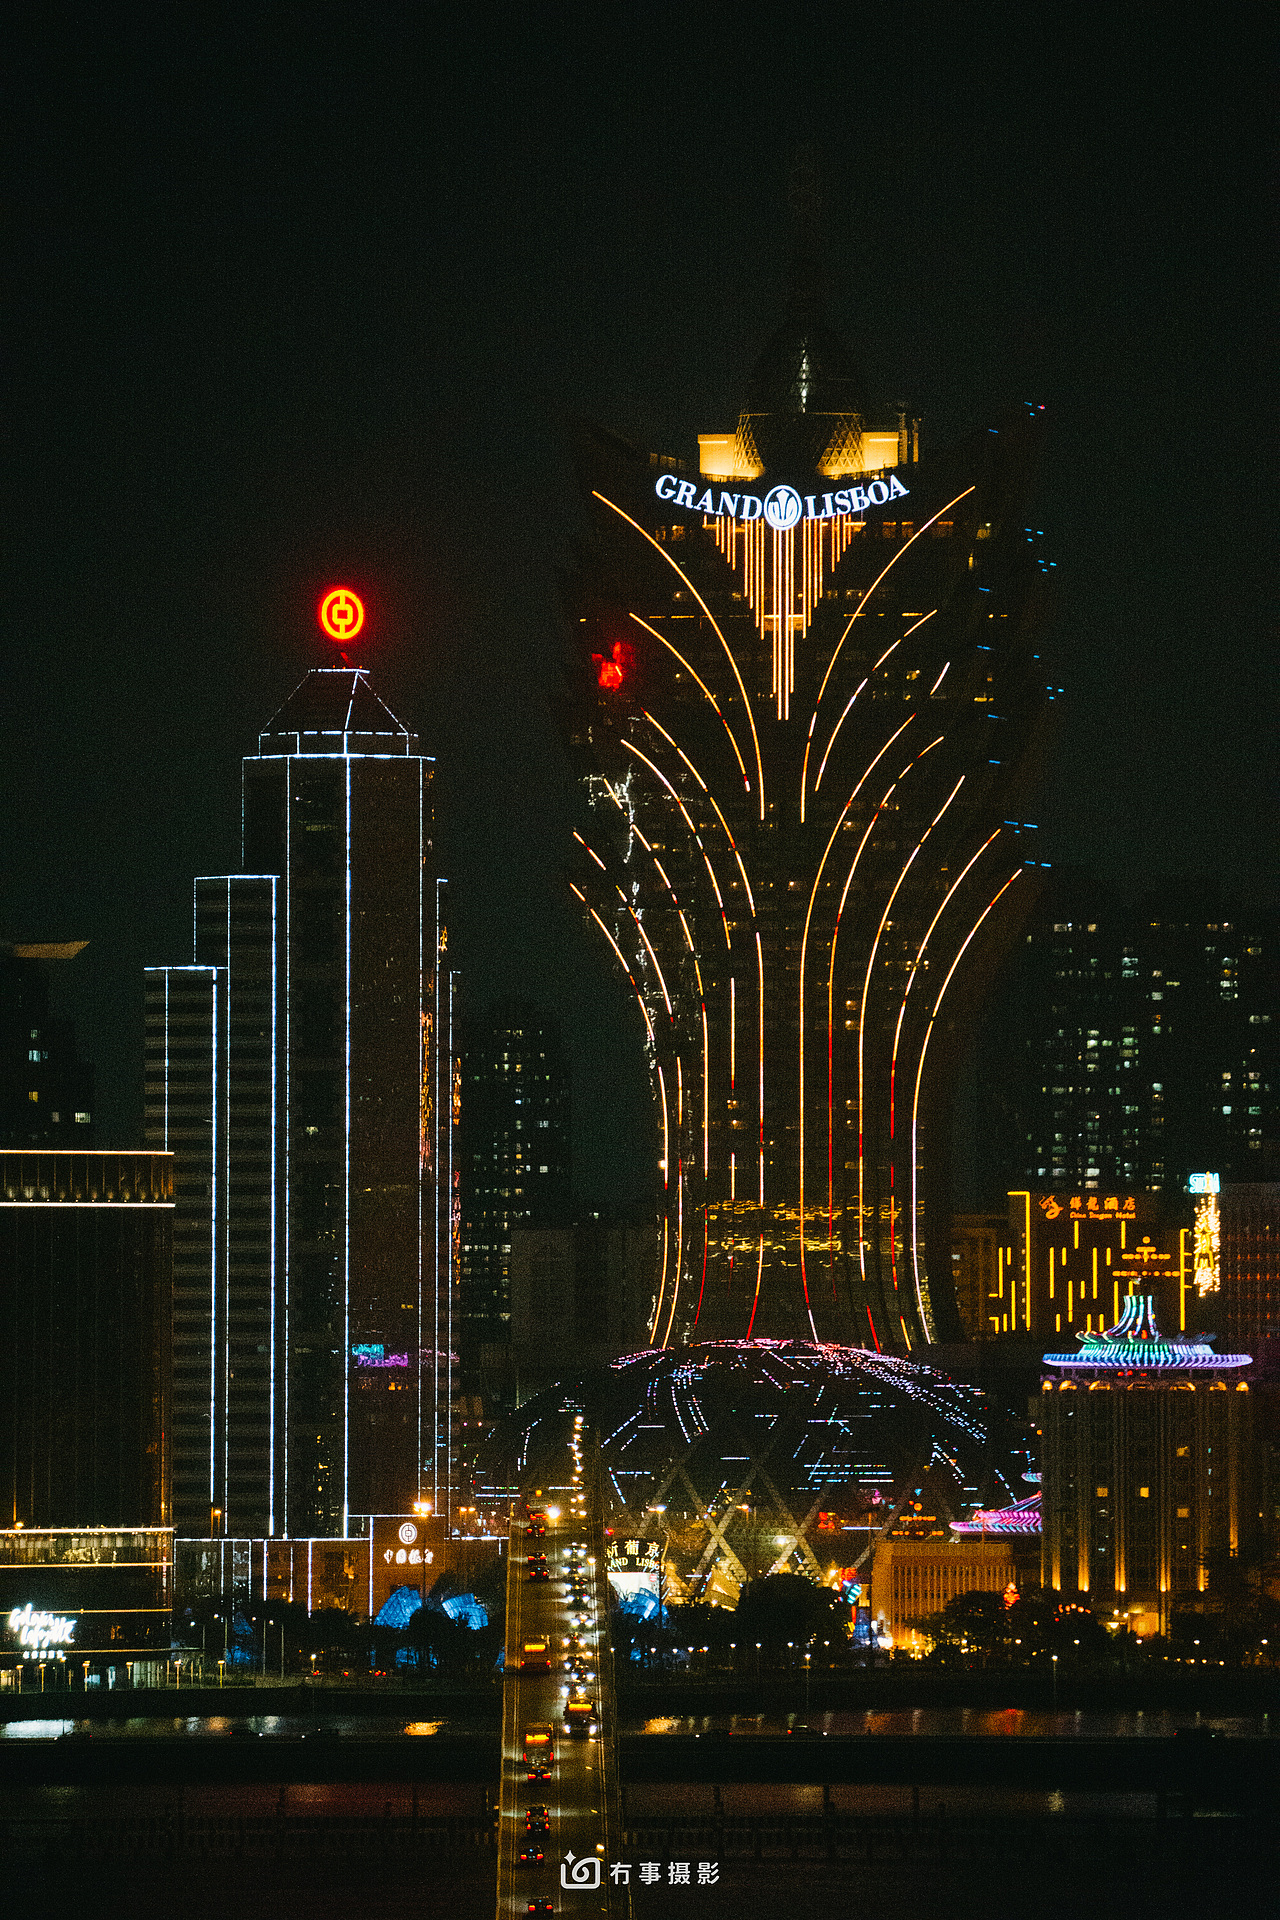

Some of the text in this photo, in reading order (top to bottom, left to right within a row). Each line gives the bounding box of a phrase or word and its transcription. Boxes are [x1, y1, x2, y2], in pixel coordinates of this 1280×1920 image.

[655, 474, 910, 521] GRAND LISBOA
[1115, 1211, 1136, 1219] Hotel
